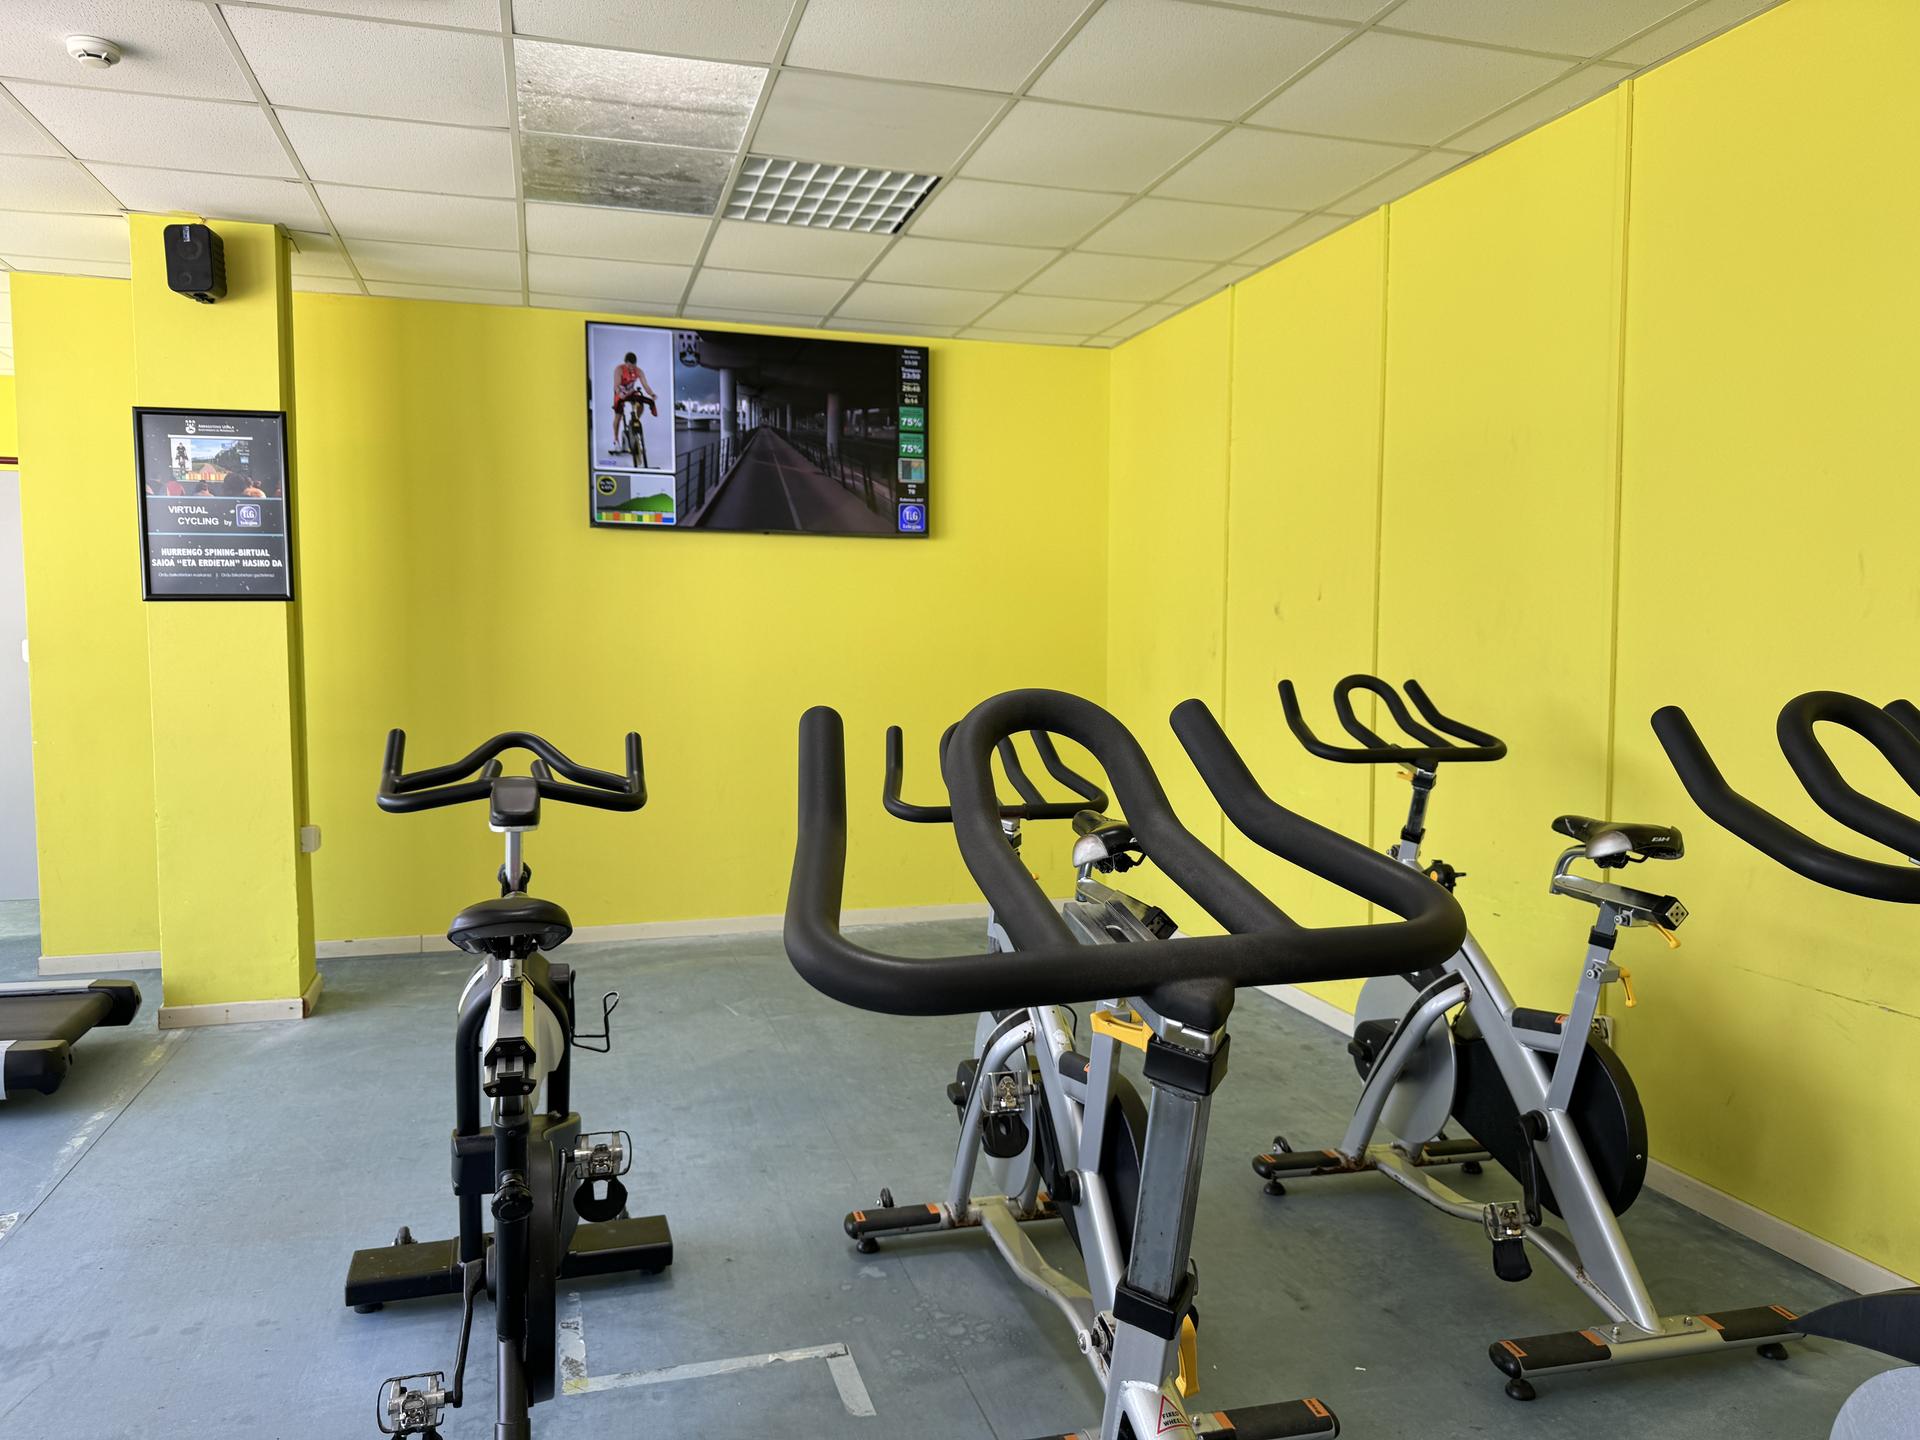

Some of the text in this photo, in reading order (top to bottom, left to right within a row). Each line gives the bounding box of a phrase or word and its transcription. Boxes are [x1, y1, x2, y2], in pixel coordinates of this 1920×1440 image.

[901, 417, 922, 427] 75%
[901, 444, 922, 453] 75%
[168, 505, 208, 514] VIRTUAL
[177, 517, 232, 527] CYCLING by
[161, 548, 270, 557] HURRENGO SPINING-BIRTUAL
[151, 559, 175, 567] SAIOA
[242, 559, 270, 567] HASIKO
[1162, 1411, 1179, 1419] FIXED
[1163, 1418, 1184, 1426] WHEEL
